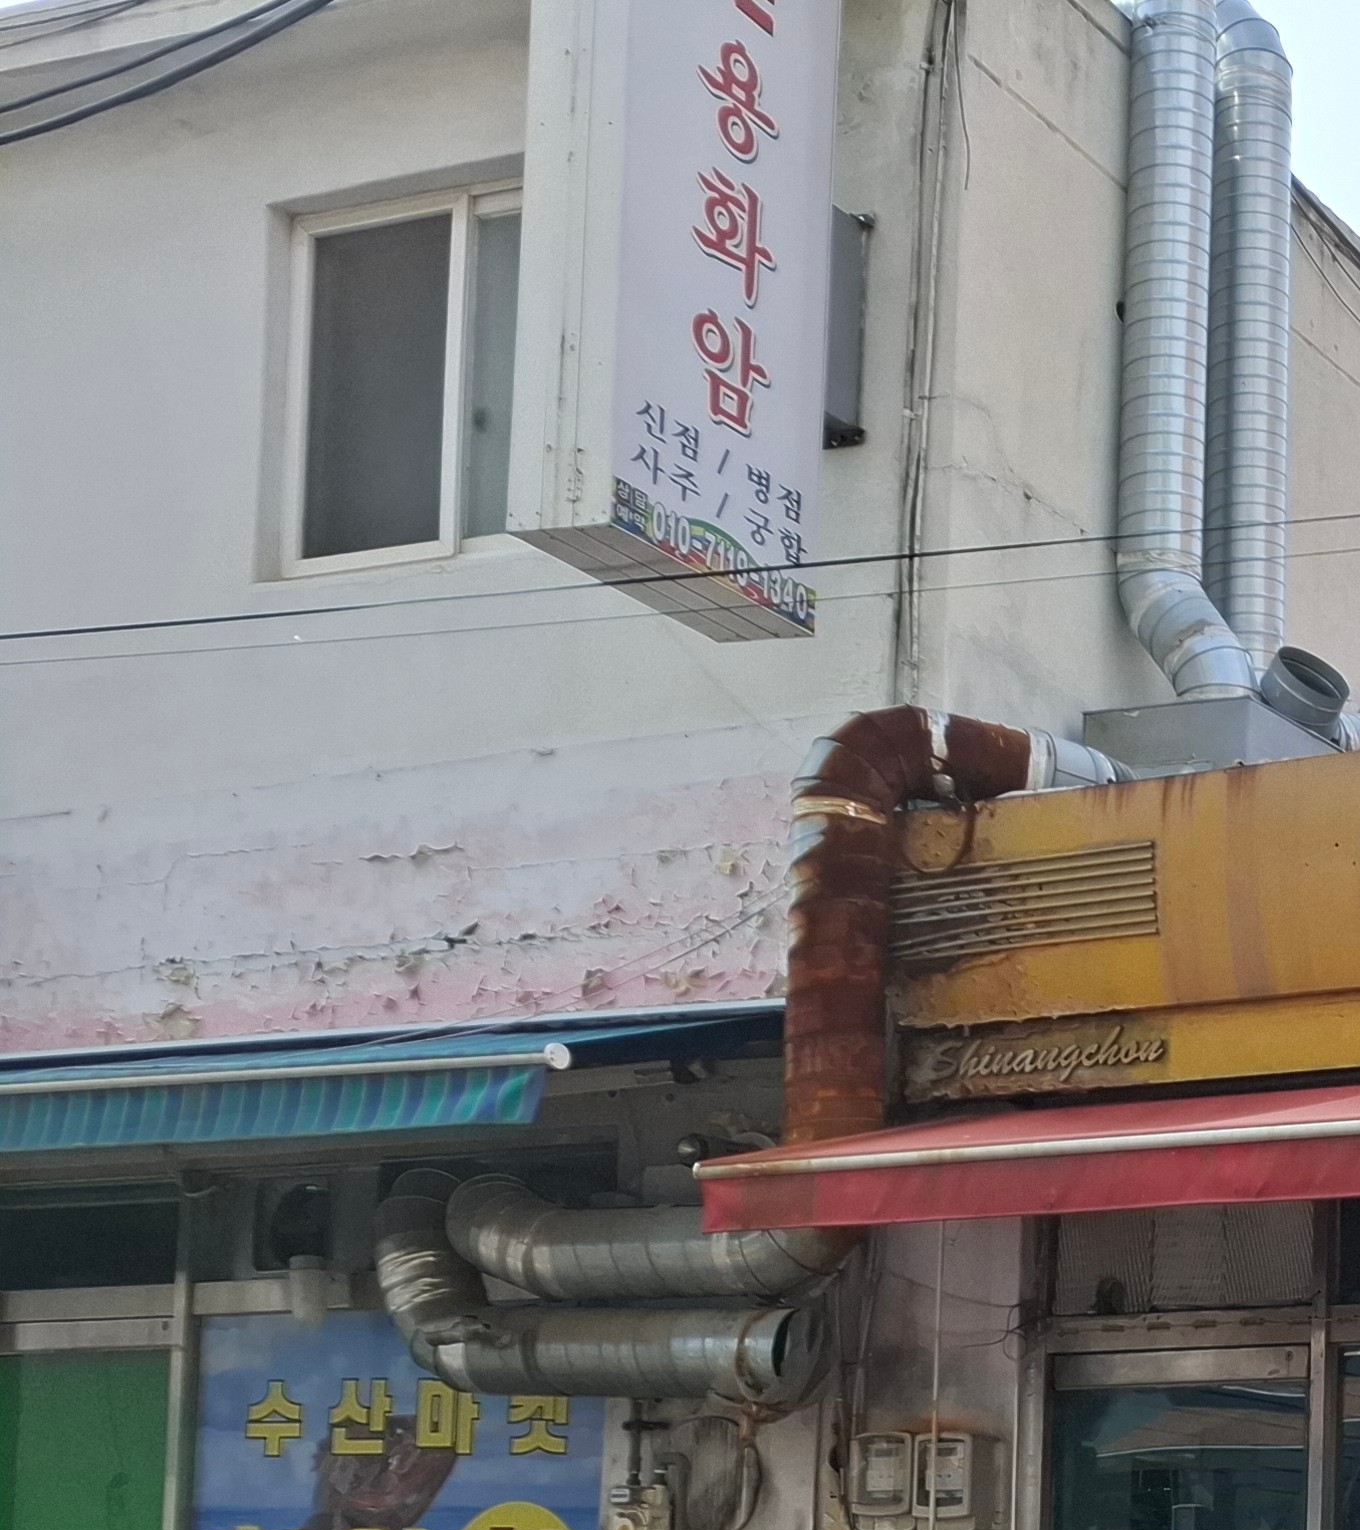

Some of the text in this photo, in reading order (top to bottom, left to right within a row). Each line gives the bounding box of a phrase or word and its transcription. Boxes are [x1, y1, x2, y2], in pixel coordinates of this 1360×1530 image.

[691, 0, 779, 437] 용화암
[636, 401, 700, 464] 신점
[632, 444, 701, 502] 사주
[246, 1378, 569, 1456] 수산마켓
